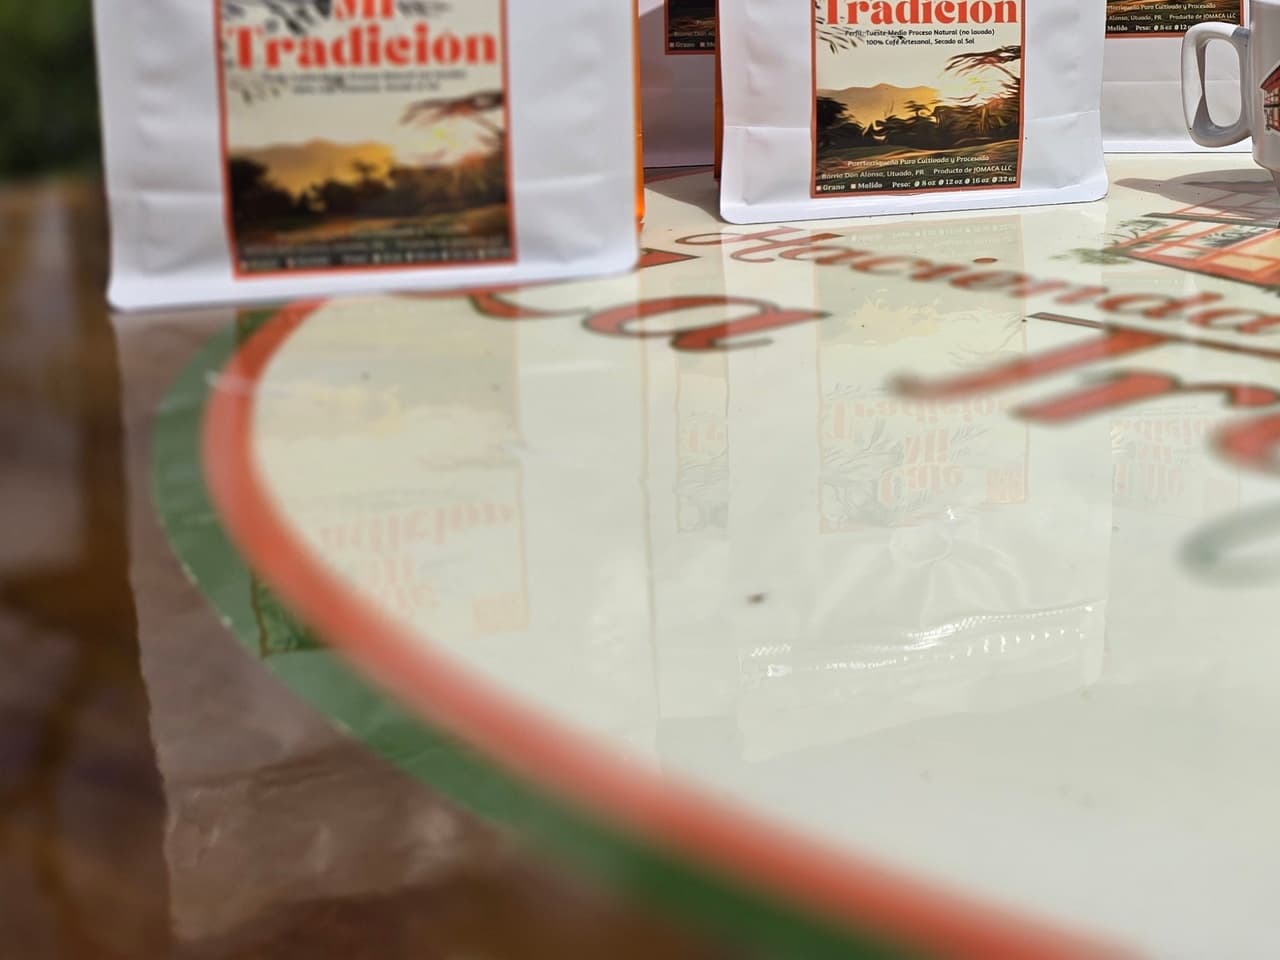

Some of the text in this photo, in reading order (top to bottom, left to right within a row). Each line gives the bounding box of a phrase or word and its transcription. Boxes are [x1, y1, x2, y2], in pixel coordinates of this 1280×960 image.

[885, 38, 899, 46] Café
[917, 156, 949, 165] Cultivado
[951, 157, 956, 165] y
[956, 154, 990, 163] Procesado
[915, 168, 925, 176] PR
[933, 167, 963, 175] Producto
[972, 166, 1000, 174] JOMACA
[822, 183, 846, 191] Grano
[857, 181, 883, 190] Molido
[892, 180, 911, 188] Peso:
